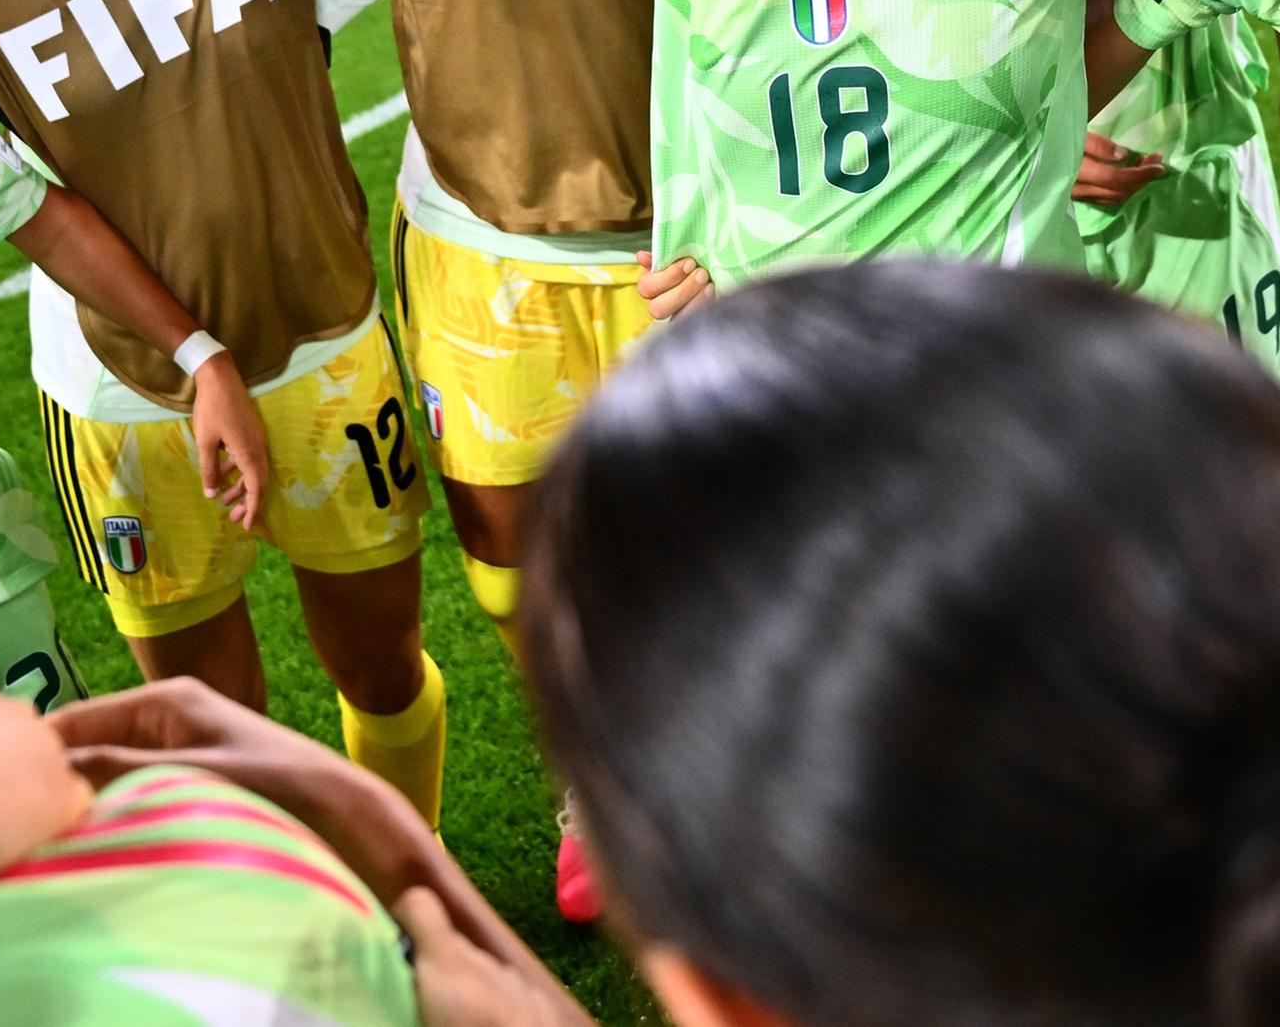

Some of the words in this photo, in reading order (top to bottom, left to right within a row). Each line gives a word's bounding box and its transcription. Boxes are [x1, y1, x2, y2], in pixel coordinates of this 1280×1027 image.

[768, 66, 892, 196] 18
[345, 396, 417, 508] 12
[106, 520, 139, 532] ITALIA
